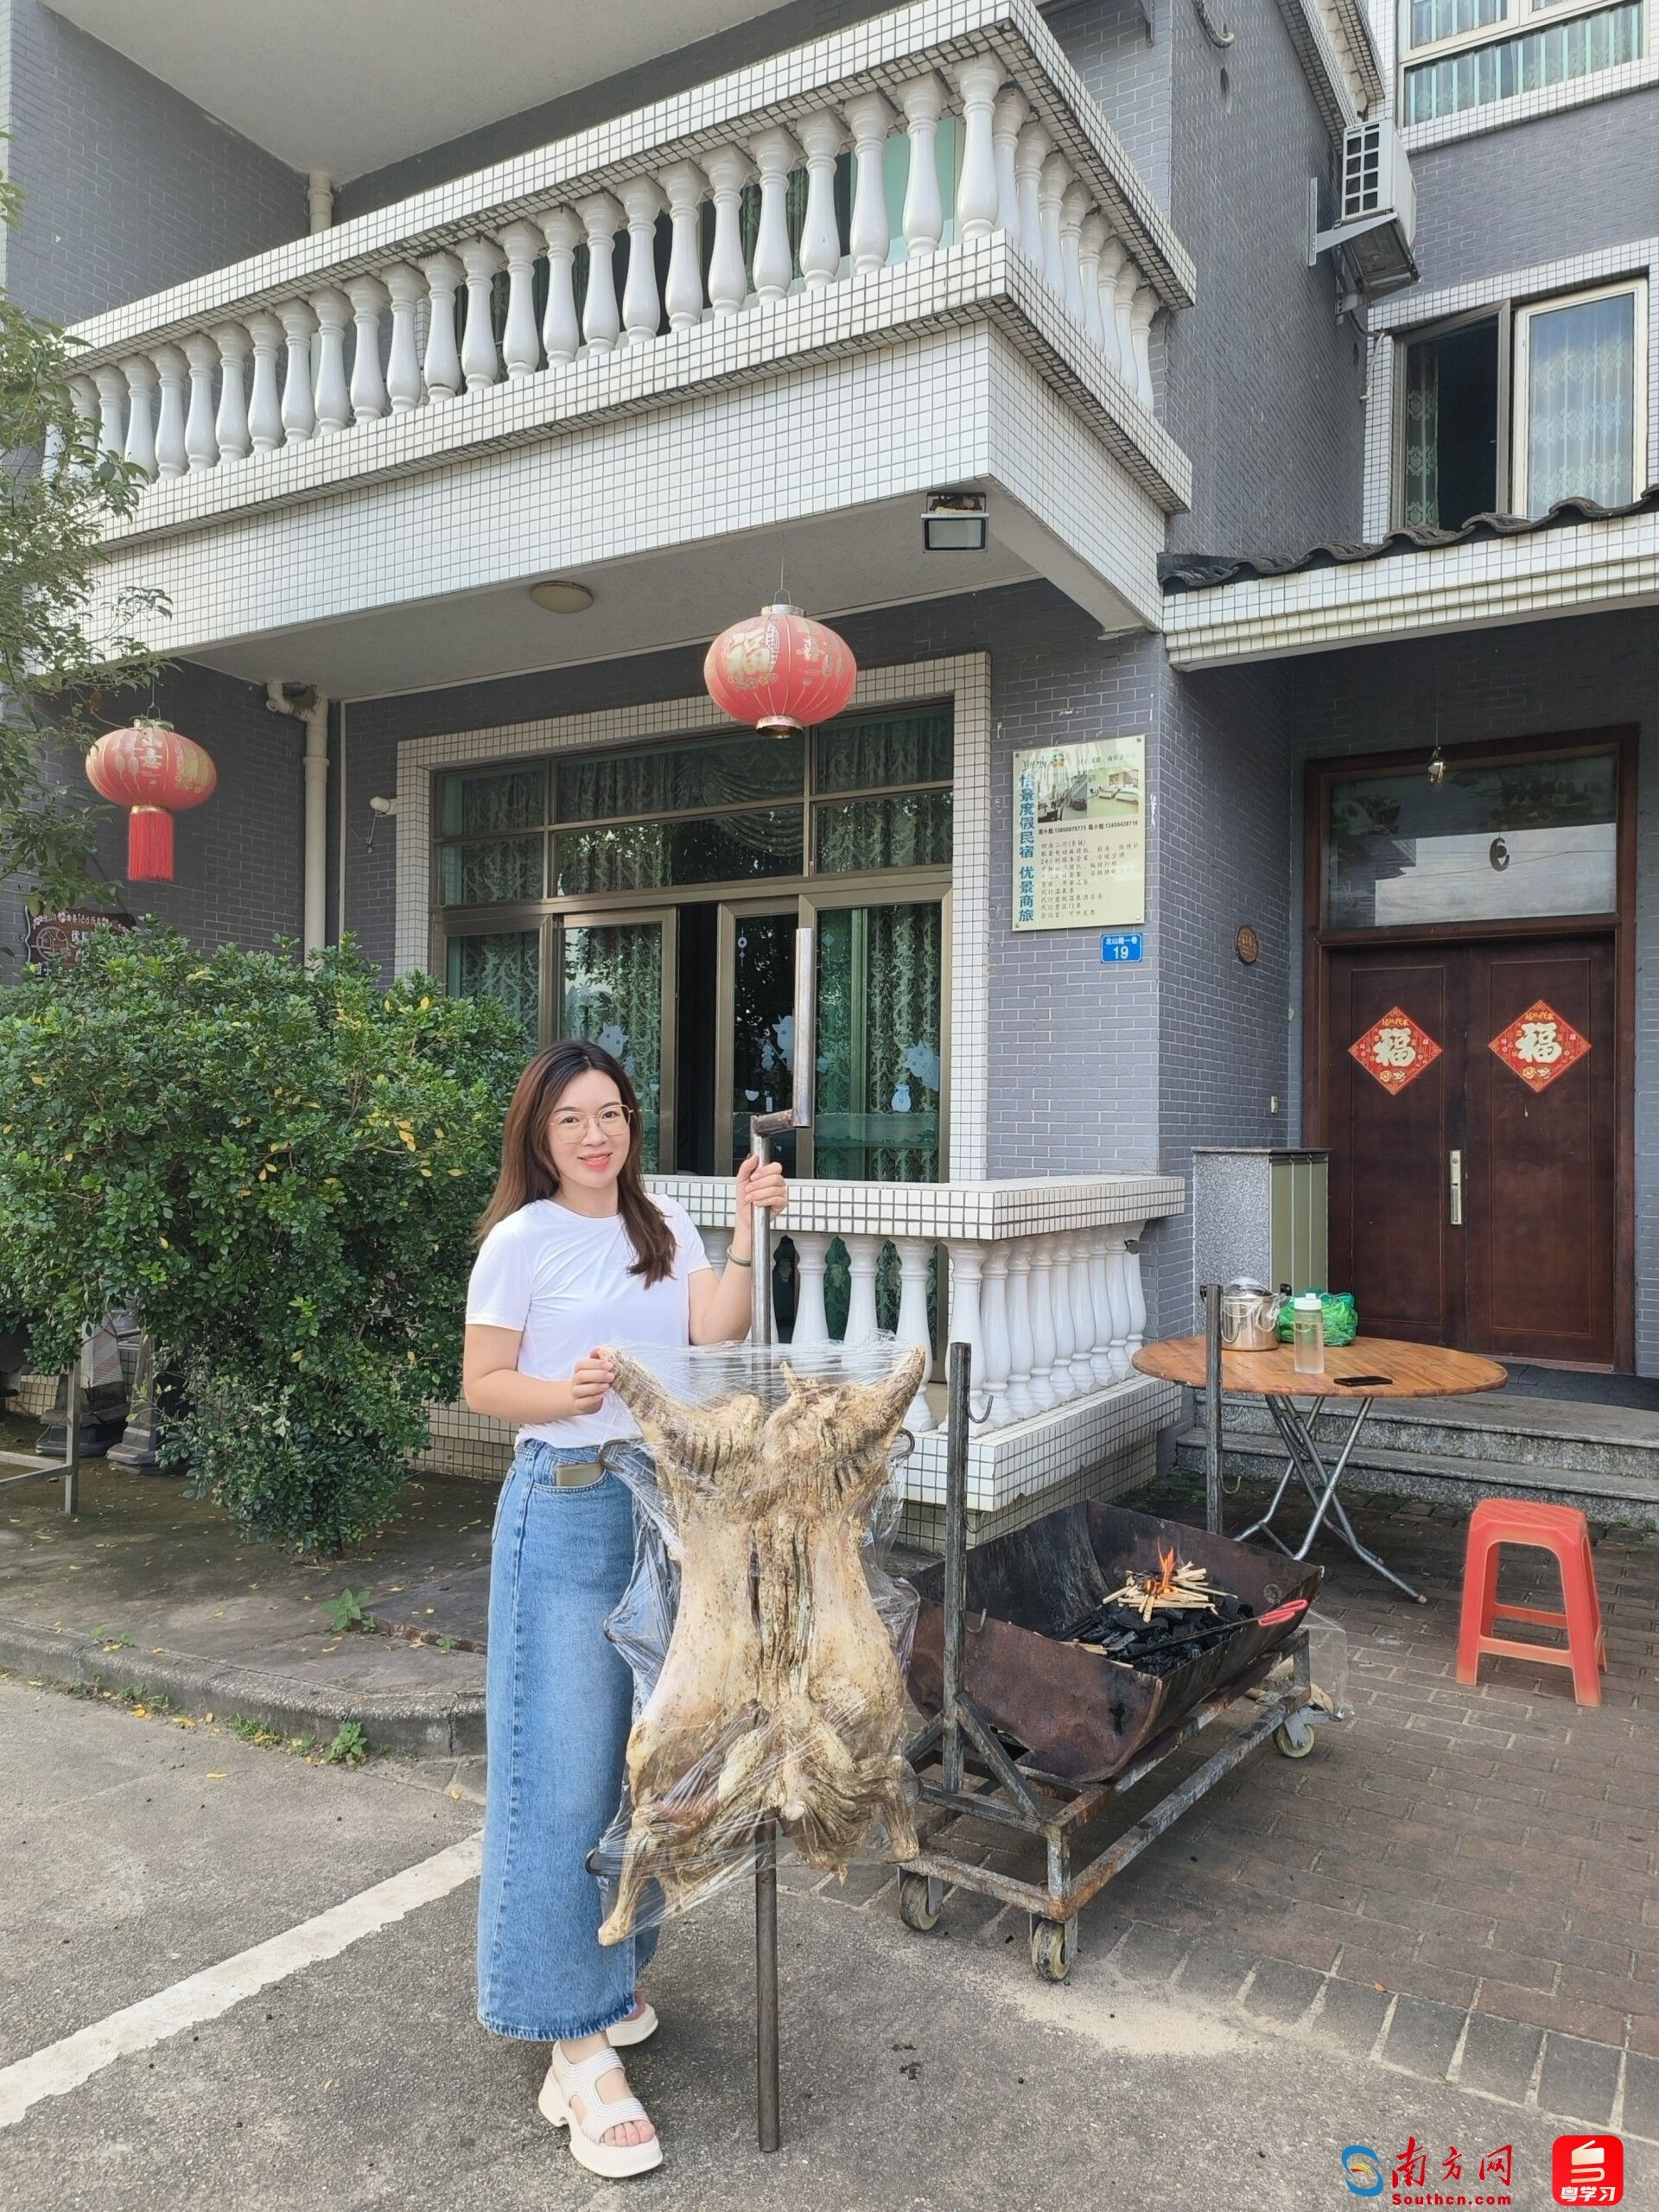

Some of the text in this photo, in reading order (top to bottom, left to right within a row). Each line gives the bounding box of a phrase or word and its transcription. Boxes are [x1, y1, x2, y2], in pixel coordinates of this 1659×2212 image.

[1019, 866, 1034, 922] 优景商旅
[1113, 946, 1128, 959] 19
[1372, 1027, 1416, 1067] 福
[1516, 1022, 1562, 1064] 福
